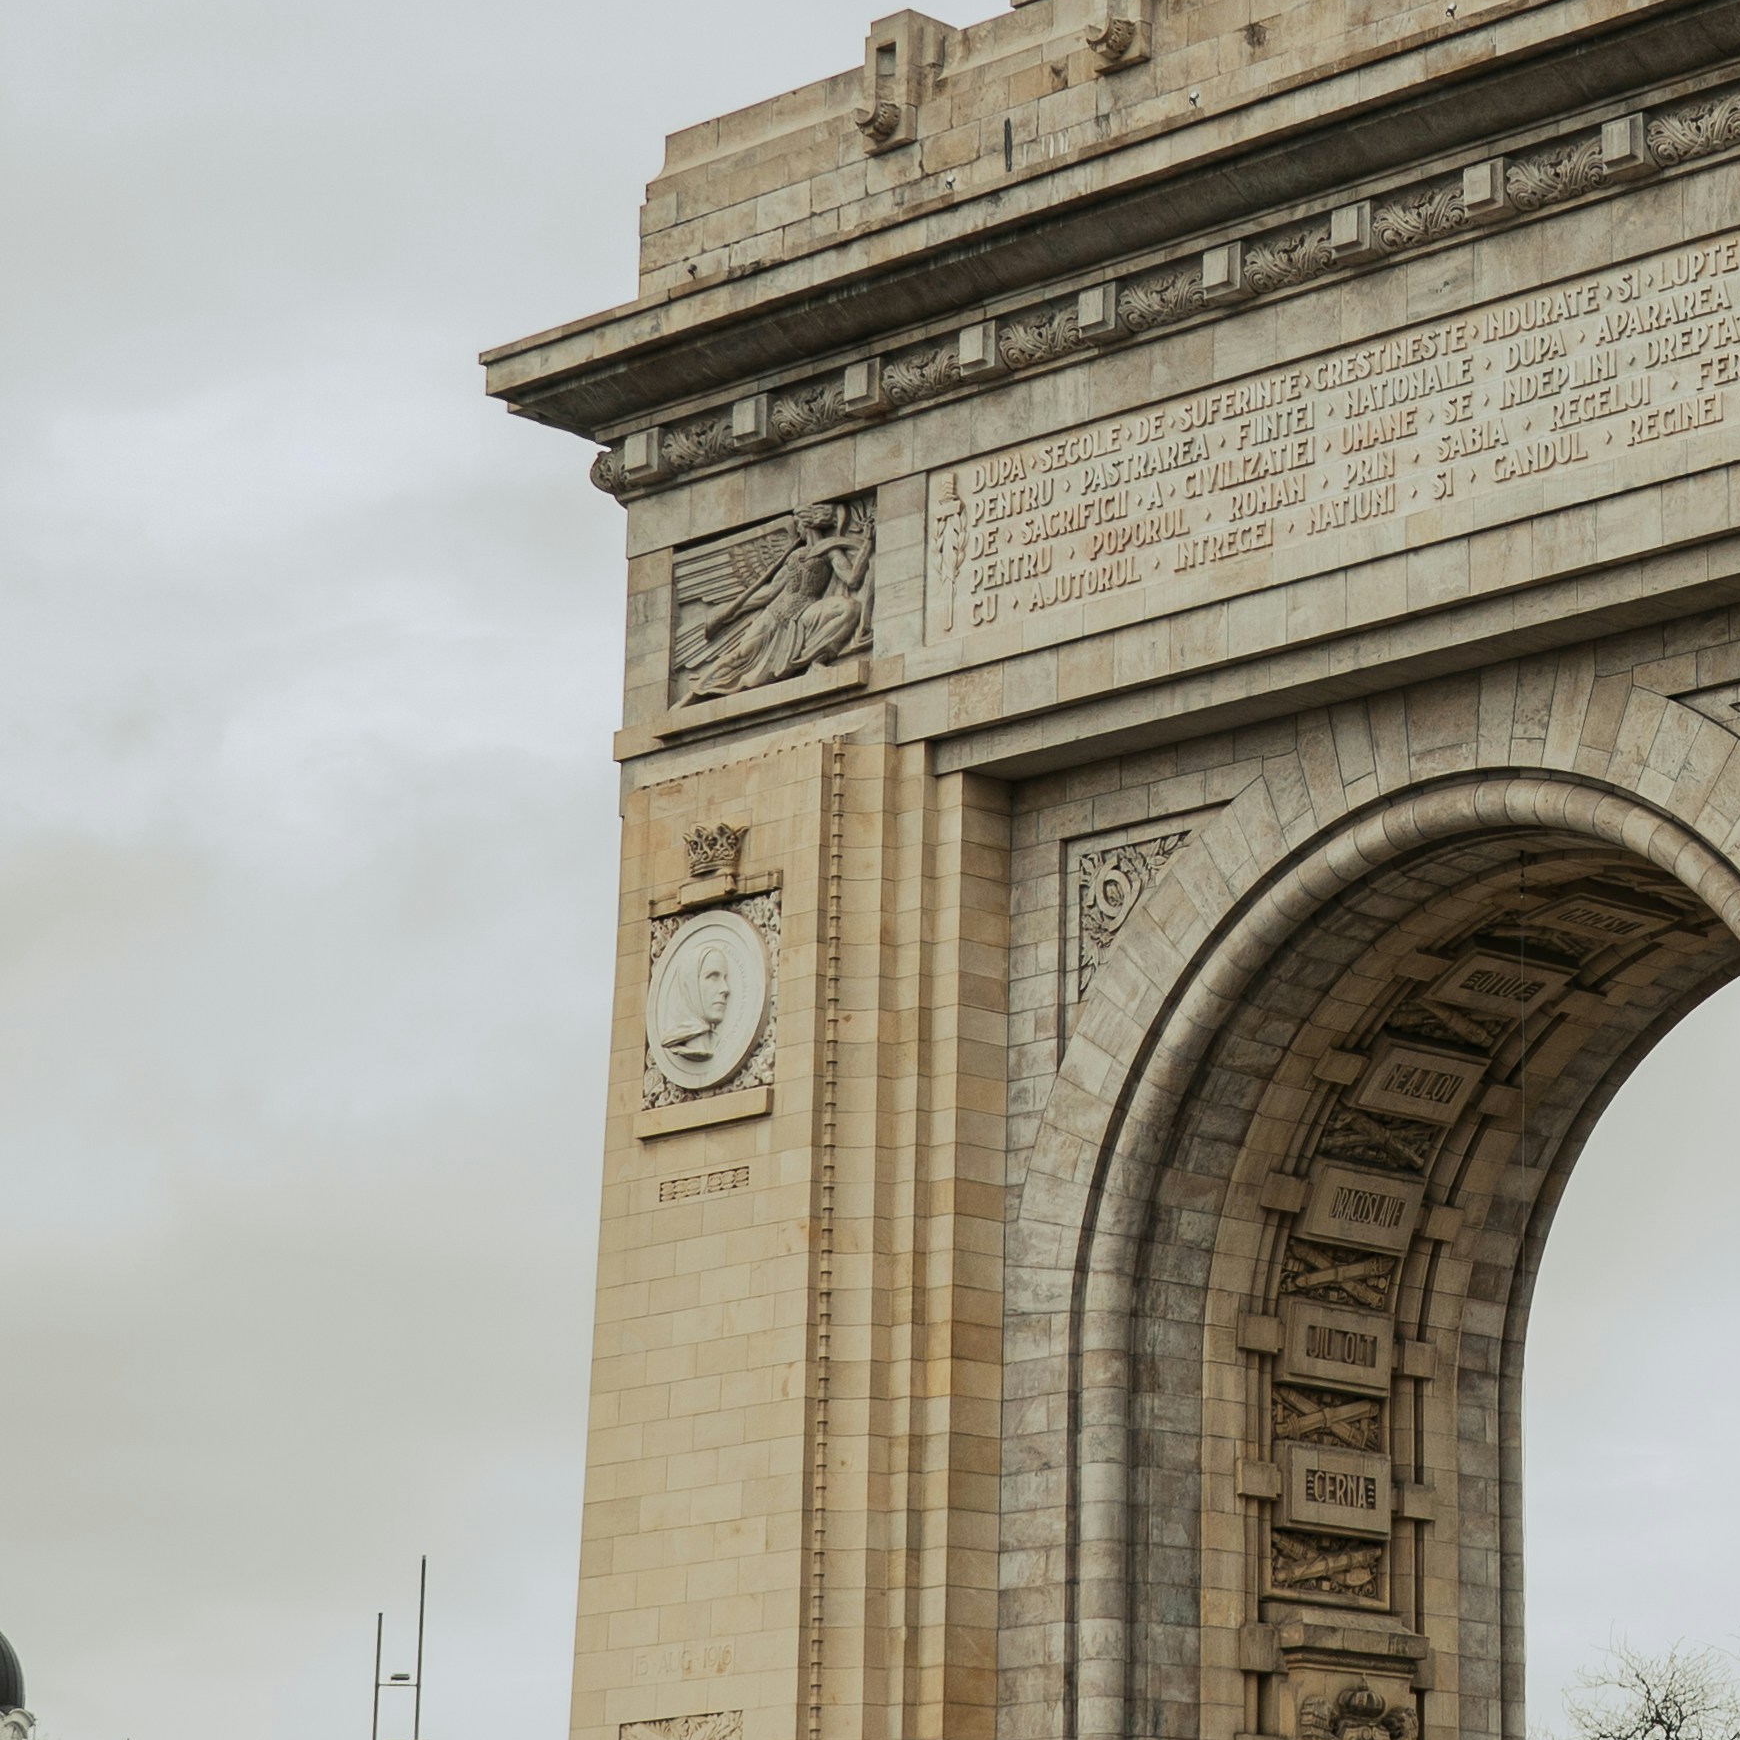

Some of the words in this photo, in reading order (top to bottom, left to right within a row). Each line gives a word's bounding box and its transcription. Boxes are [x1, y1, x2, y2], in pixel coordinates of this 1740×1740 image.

[971, 528, 997, 559] DE
[1021, 491, 1127, 545] SACRIFICII
[1147, 481, 1162, 509] A
[1184, 437, 1314, 499] CIVILIZATIEI
[1339, 407, 1416, 454] UMANE
[1443, 392, 1471, 424] SE
[1500, 350, 1616, 408] INDEPLINI
[972, 478, 1053, 526] PENTRU
[1081, 432, 1208, 494] PASTRAREA
[1237, 401, 1314, 449] FIINTEI
[1344, 355, 1472, 418] NATIONALE
[1505, 328, 1565, 372] DUPA
[1595, 280, 1731, 345] APARAREA
[973, 453, 1025, 492] DUPA
[1040, 424, 1120, 472] SECOLE
[1136, 411, 1163, 444] DE
[1180, 370, 1300, 431] SUFERINTE
[1314, 320, 1466, 392] CRESTINESTE
[1482, 282, 1598, 342] INDURATE
[1618, 270, 1640, 302] SI
[1658, 241, 1737, 290] LUPTE
[971, 546, 1051, 592] PENTRU
[1090, 507, 1189, 559] POPORUL
[1230, 474, 1304, 520] ROMAN
[1343, 450, 1392, 489] PRIN
[1437, 416, 1507, 461] SABIA
[1549, 376, 1650, 430] REGELUI
[971, 595, 997, 625] CU
[1030, 555, 1140, 609] AJUTORUL
[1175, 519, 1272, 570] INTREGEI
[1307, 486, 1394, 532] NATIUNI
[1432, 468, 1452, 498] SI
[1491, 431, 1587, 482] GANDUL
[1627, 393, 1723, 445] REGINEI
[1382, 1064, 1464, 1104] NEAJLOV
[1314, 1471, 1367, 1508] CERNA
